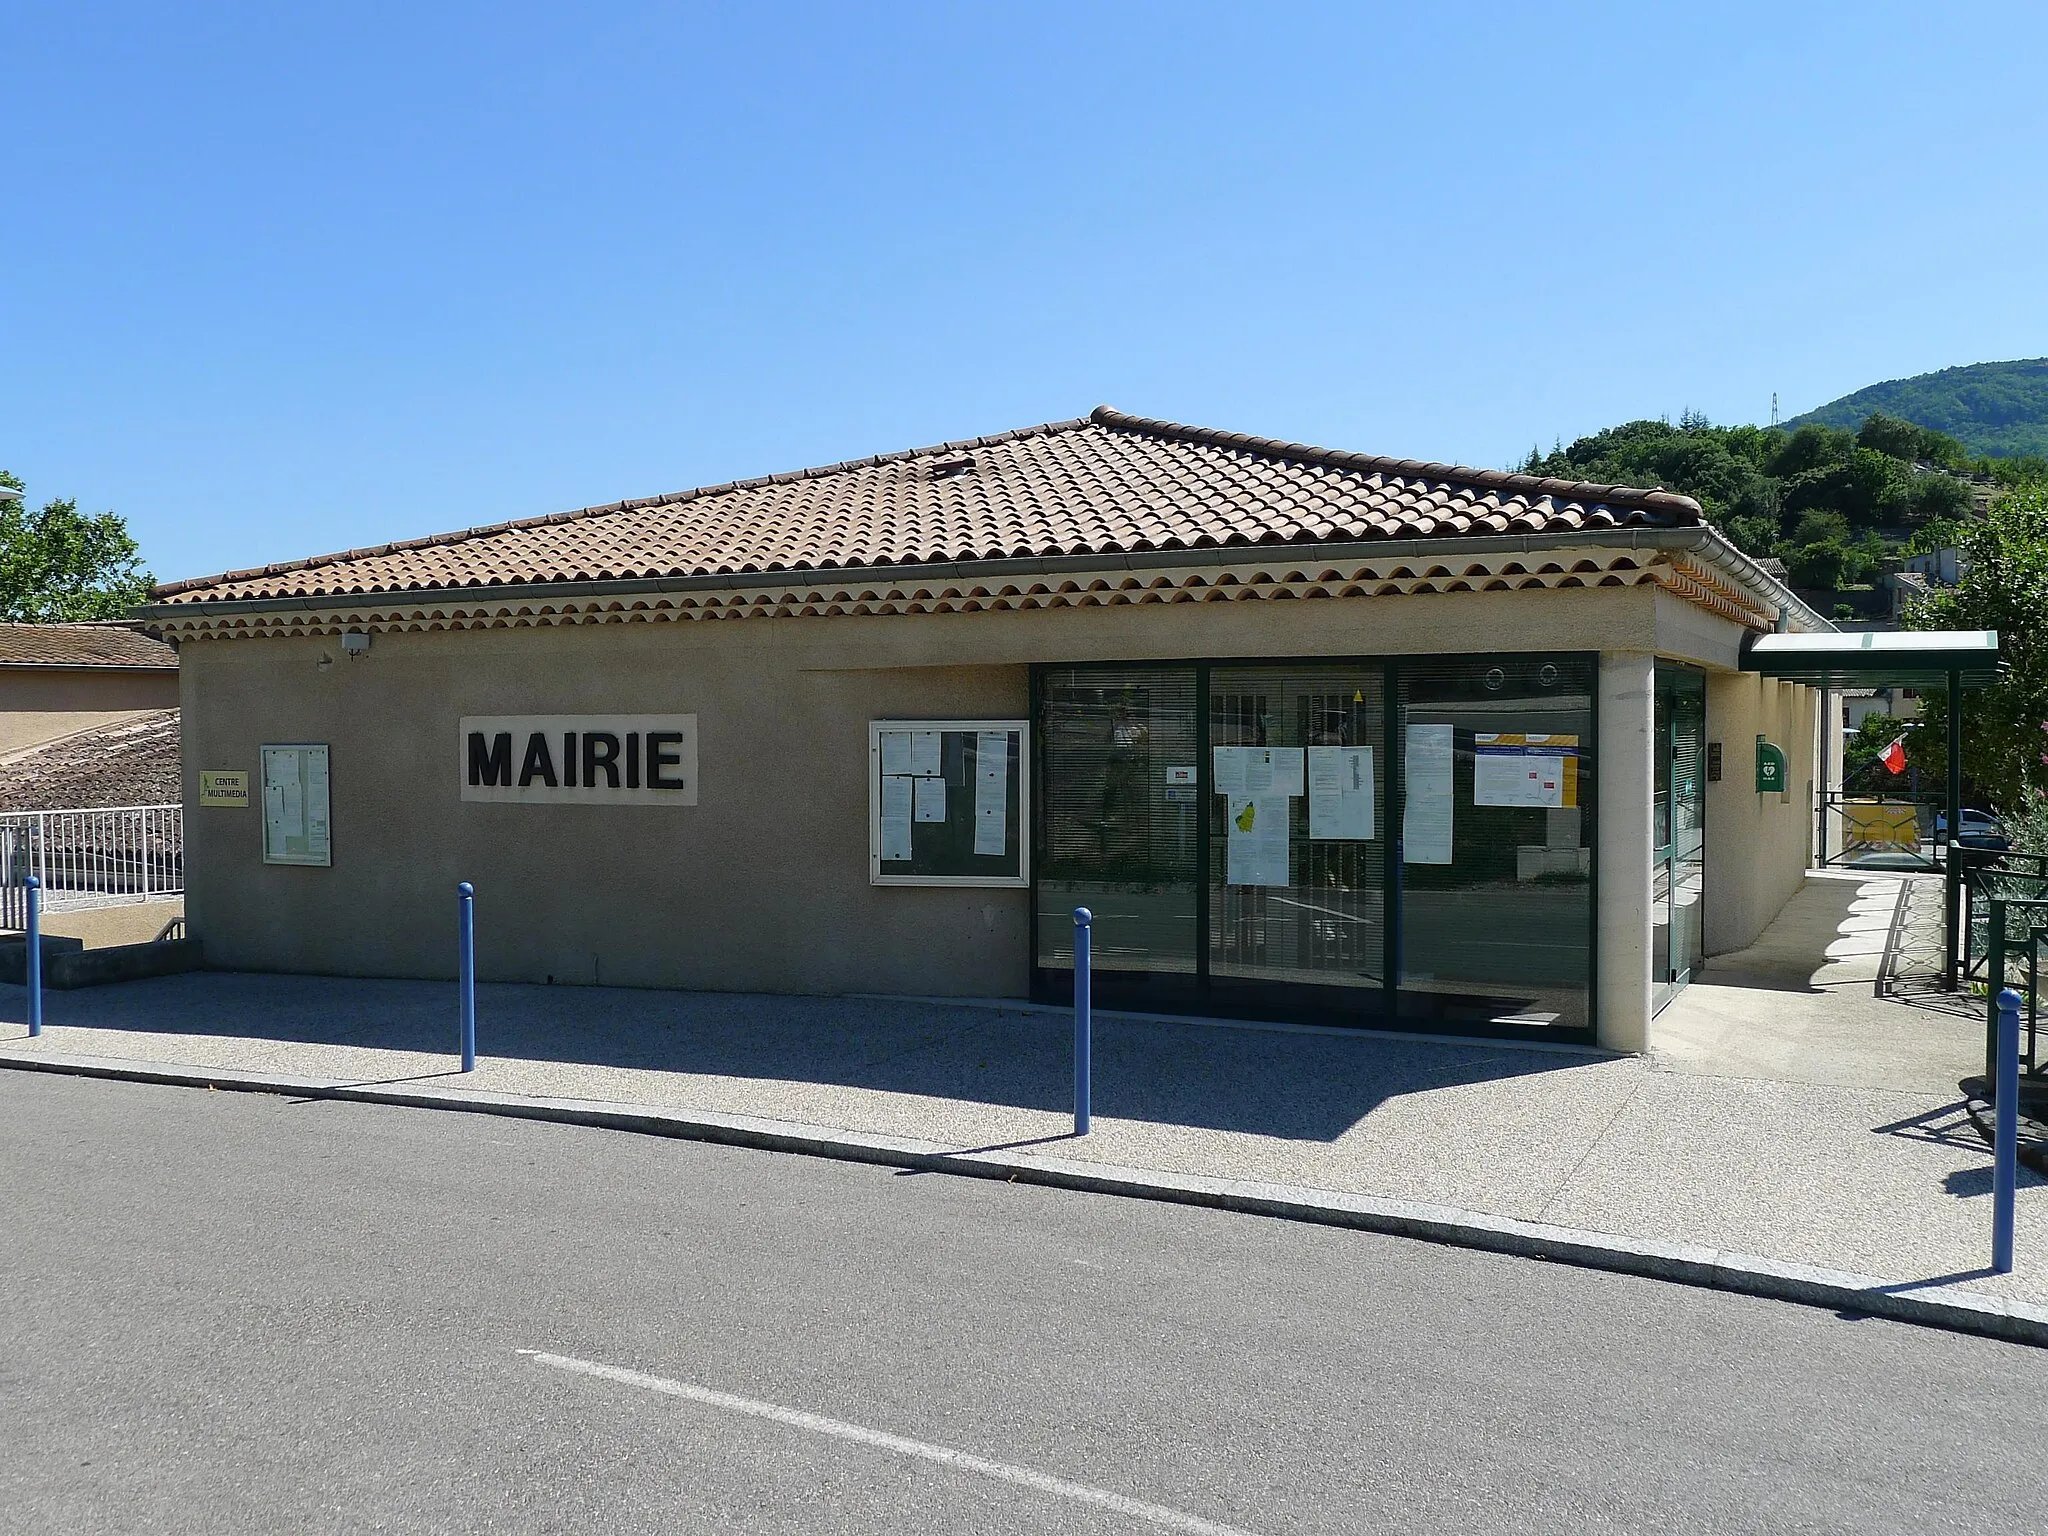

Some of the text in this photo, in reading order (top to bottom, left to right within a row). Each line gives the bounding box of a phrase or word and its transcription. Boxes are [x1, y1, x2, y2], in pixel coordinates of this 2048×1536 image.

[467, 732, 684, 789] MAIRIE
[215, 777, 239, 786] CENTRE
[207, 790, 247, 798] MULTIMEDIA
